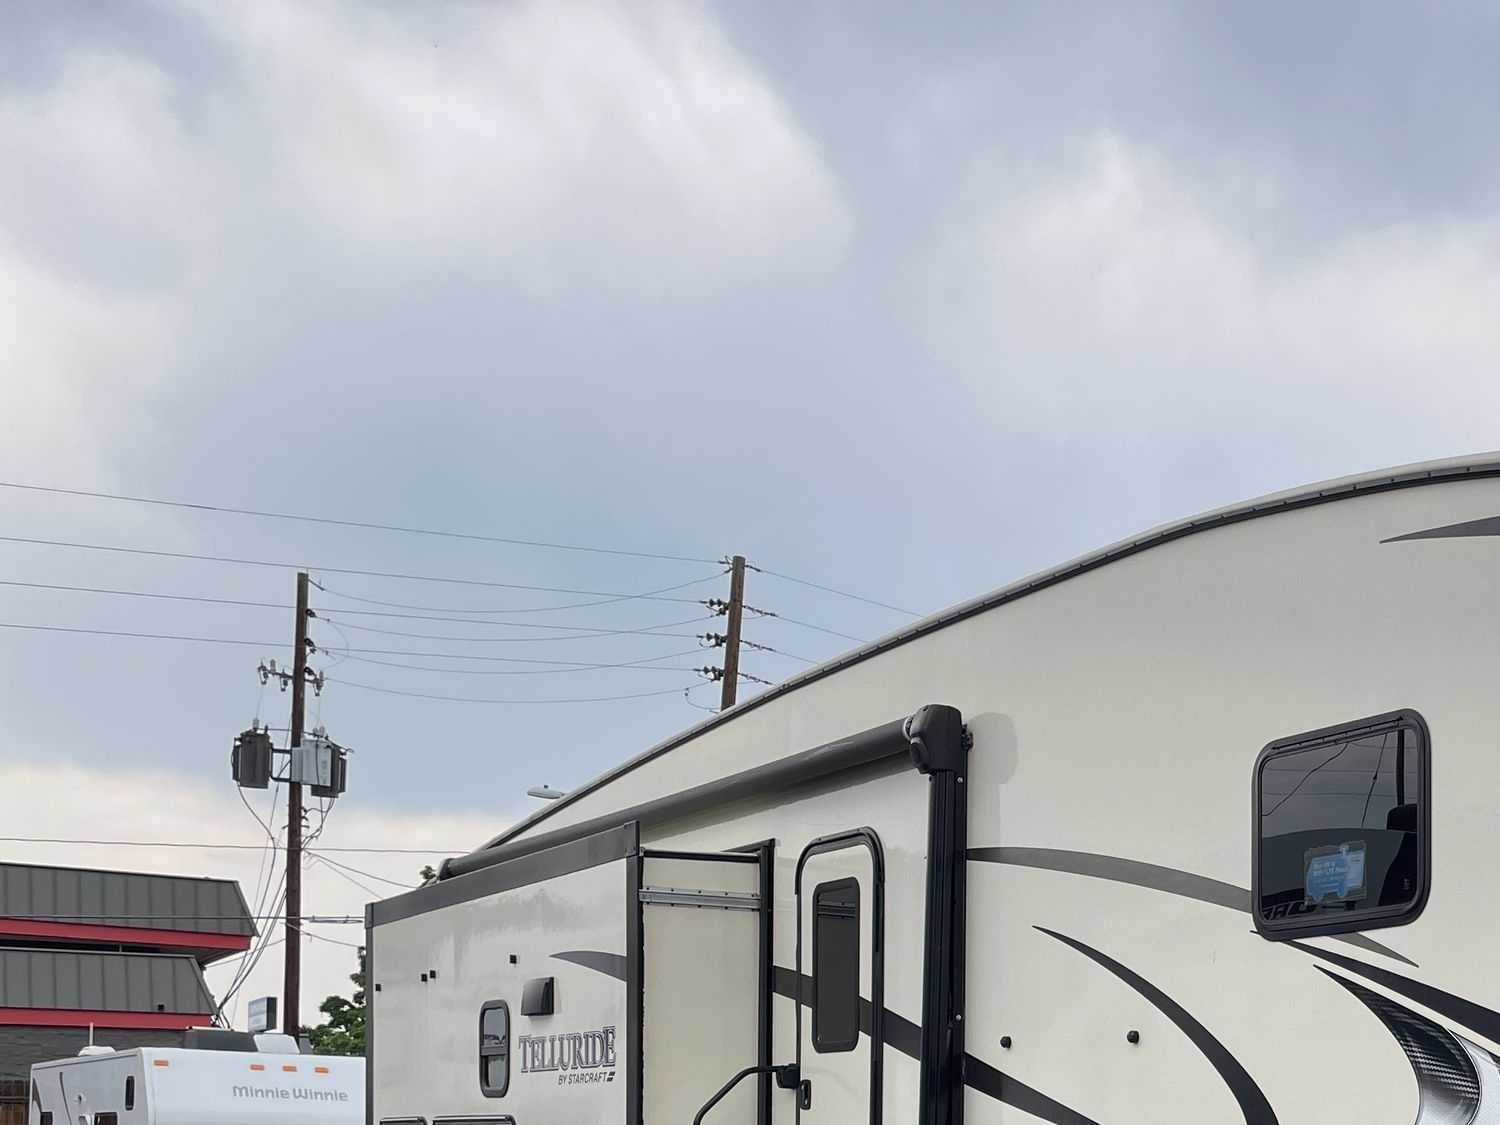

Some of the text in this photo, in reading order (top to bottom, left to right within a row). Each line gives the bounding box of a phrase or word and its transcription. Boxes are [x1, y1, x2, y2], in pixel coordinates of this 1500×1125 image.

[518, 1025, 616, 1073] TELLURIDE
[558, 1072, 608, 1085] BY STARCRAFT
[232, 1085, 349, 1102] Minnie Winnie
